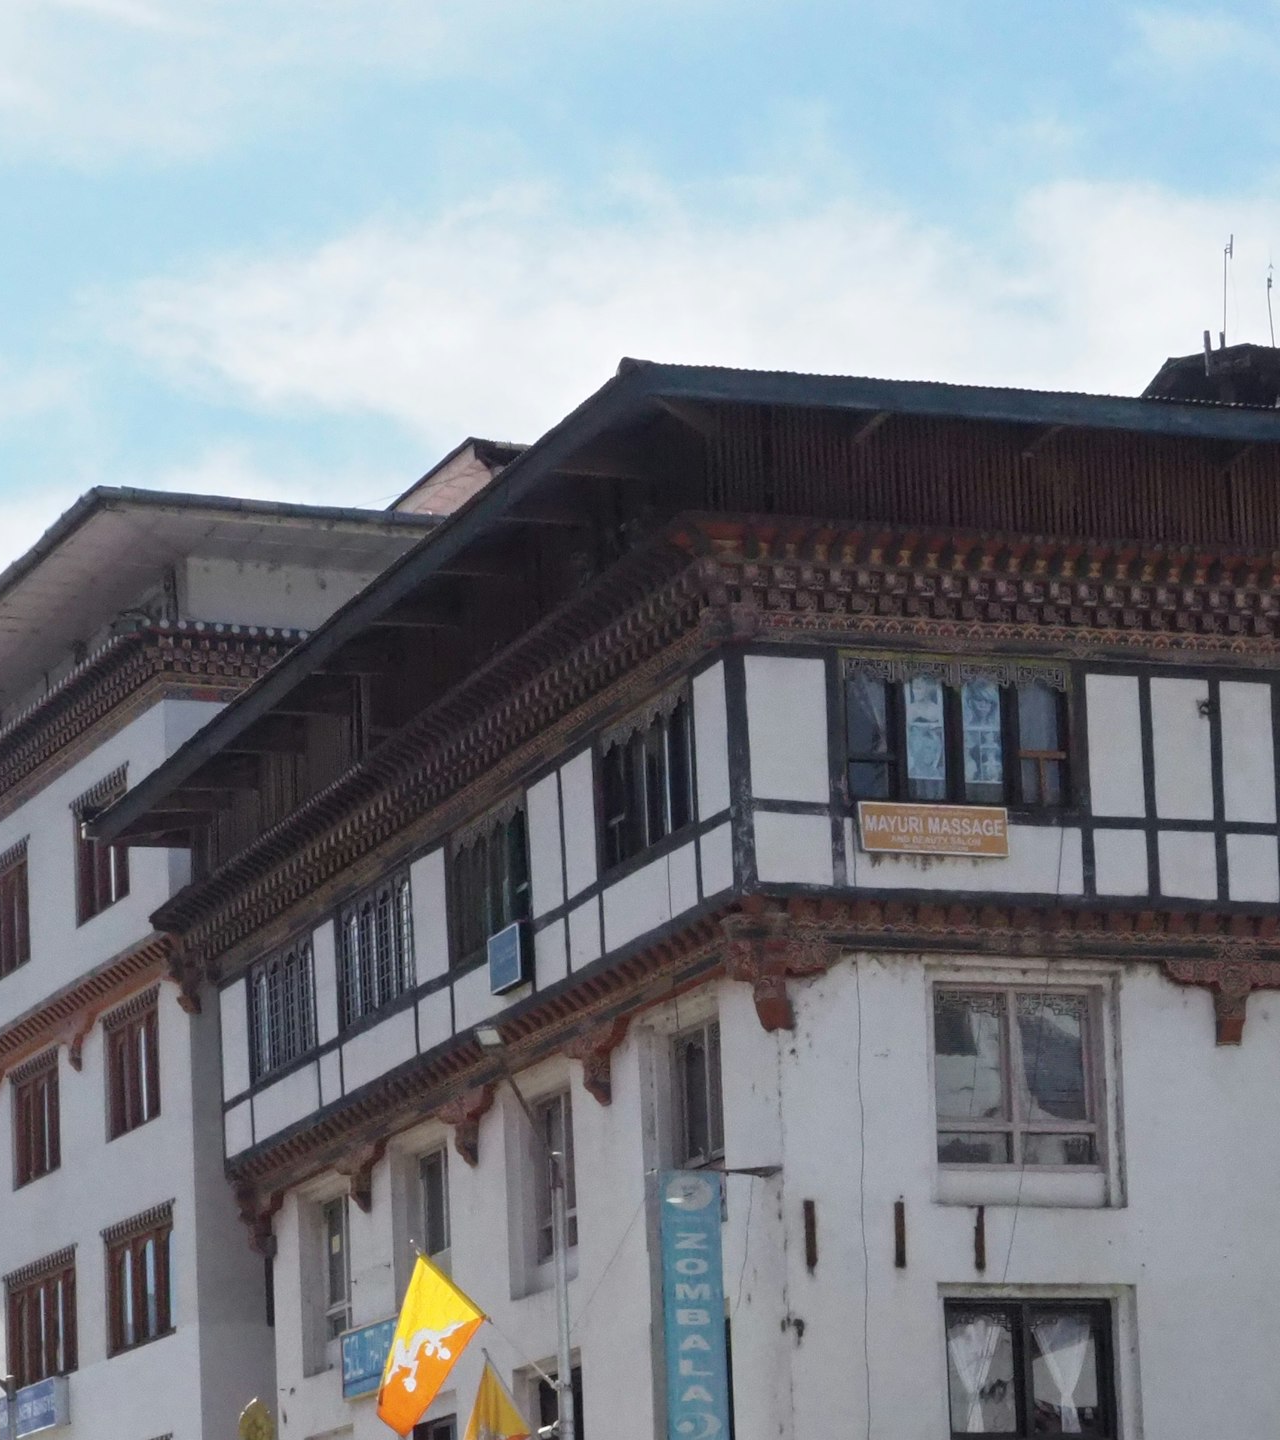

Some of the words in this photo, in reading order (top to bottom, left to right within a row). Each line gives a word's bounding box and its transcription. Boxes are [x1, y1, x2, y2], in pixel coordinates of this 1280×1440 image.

[865, 814, 923, 834] MAYURI
[928, 816, 1005, 837] MASSAGE
[912, 835, 948, 845] BEAUTY
[674, 1232, 715, 1402] ZOMBALA
